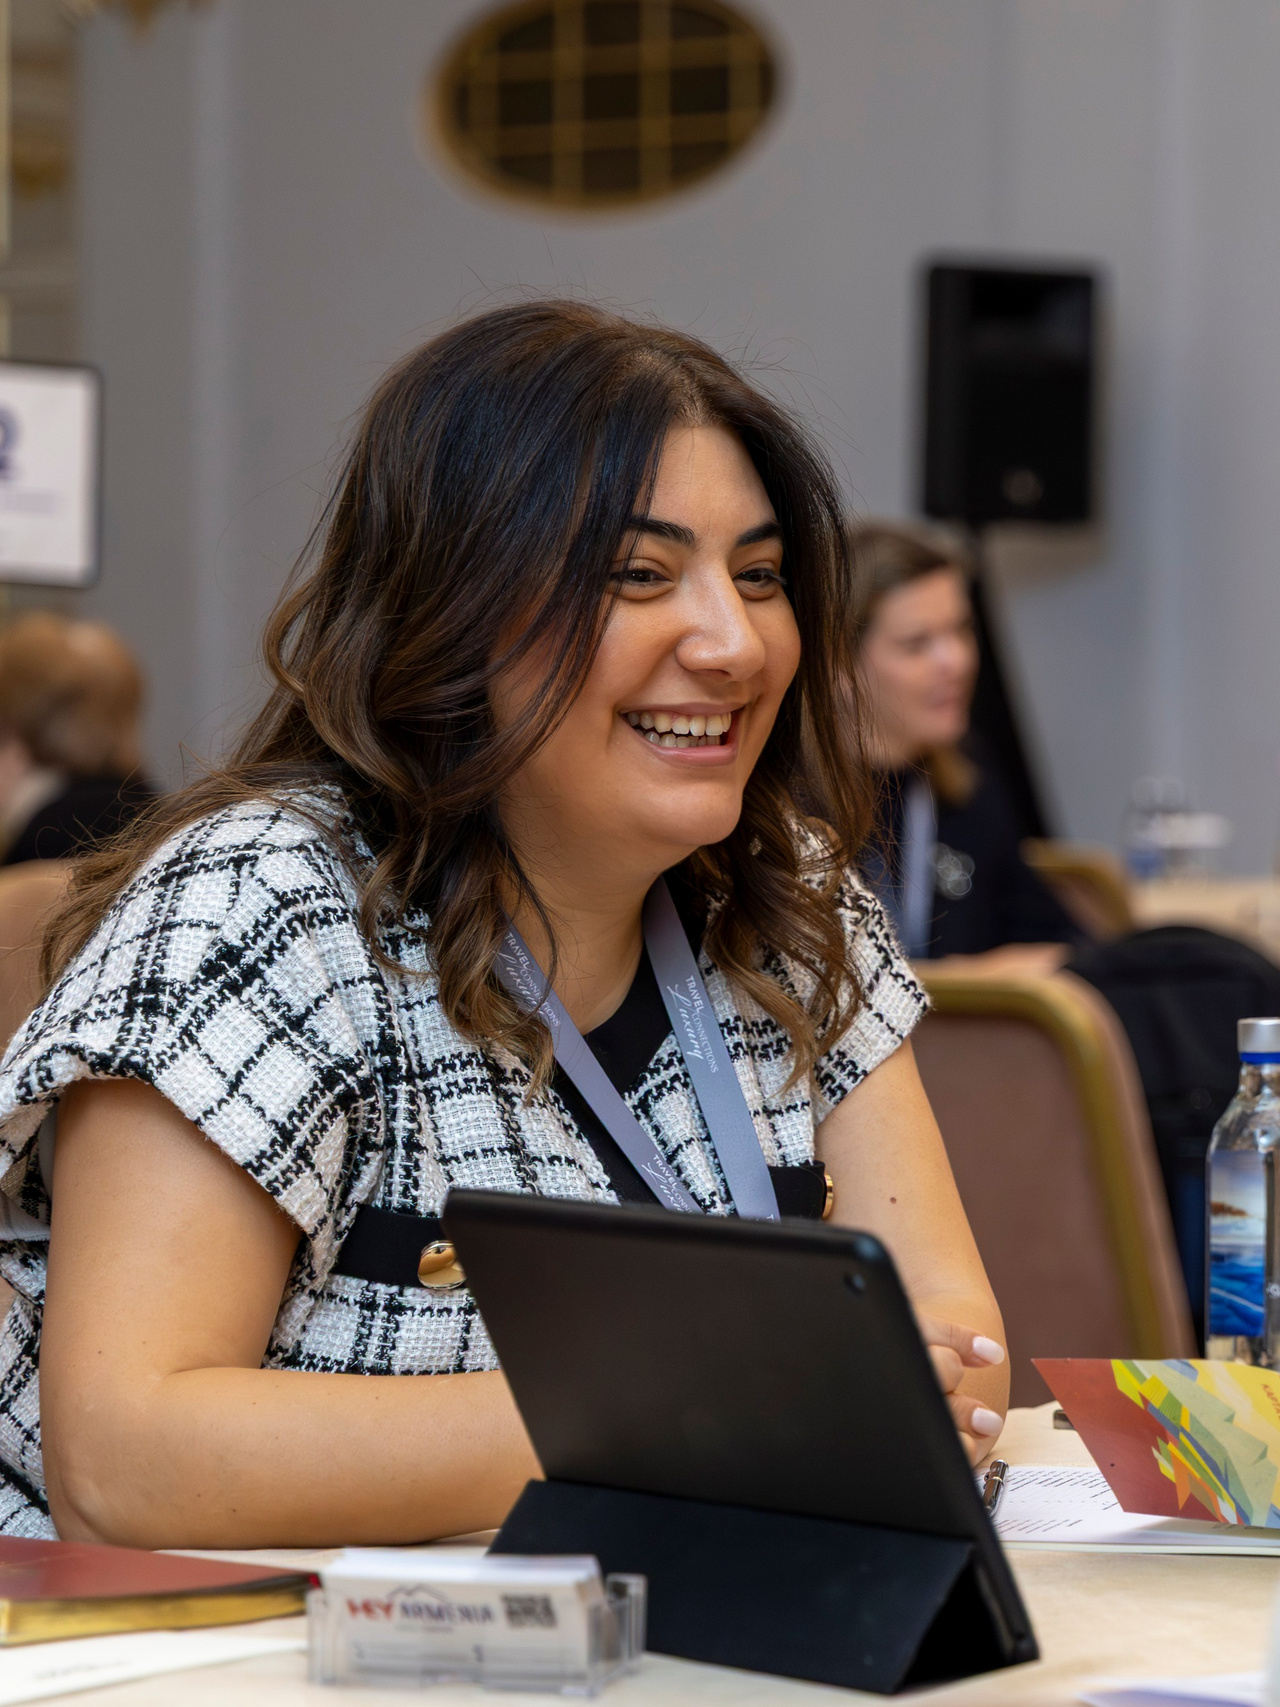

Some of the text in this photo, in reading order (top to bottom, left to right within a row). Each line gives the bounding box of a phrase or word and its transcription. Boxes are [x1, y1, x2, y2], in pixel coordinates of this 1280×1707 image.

[505, 932, 561, 1027] TRAVEL CONNETIONS
[685, 974, 719, 1074] TRAVEL CONNECTIONS
[653, 1153, 678, 1190] TRAVEL
